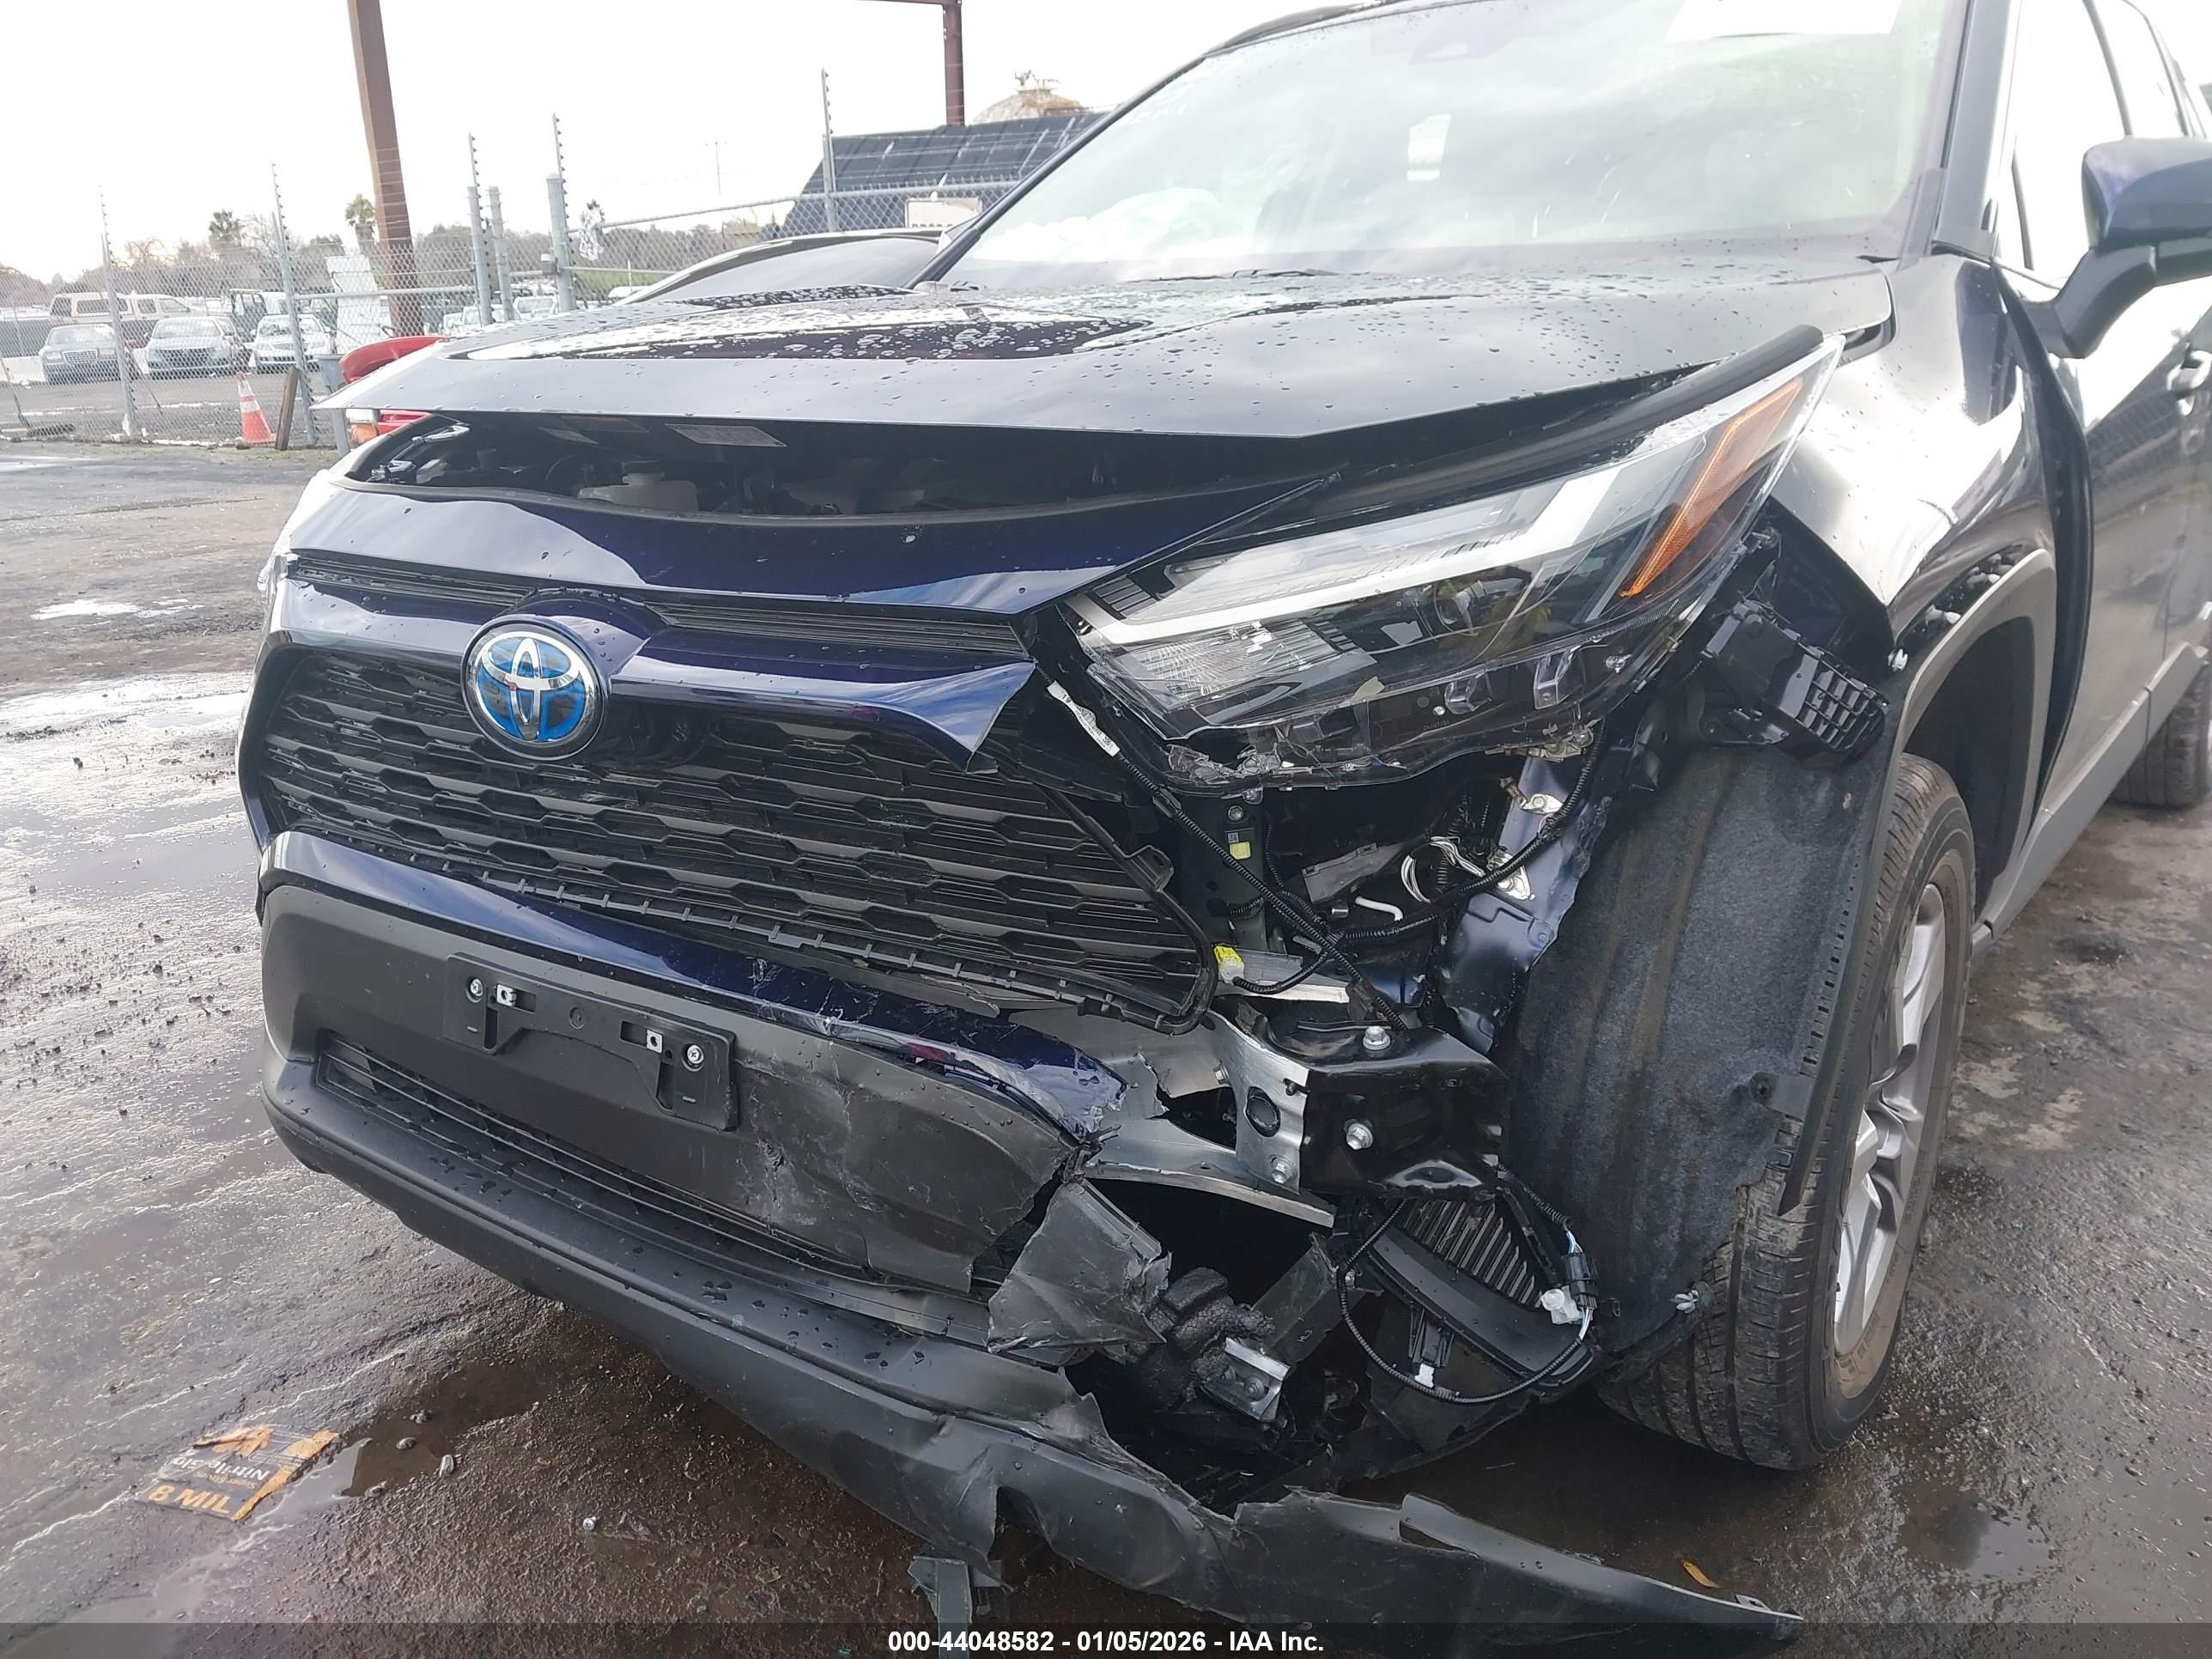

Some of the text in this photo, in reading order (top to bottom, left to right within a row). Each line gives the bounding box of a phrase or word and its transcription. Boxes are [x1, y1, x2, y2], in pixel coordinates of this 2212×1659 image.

[208, 1460, 270, 1480] Nitrile
[149, 1484, 230, 1514] 8 MIL
